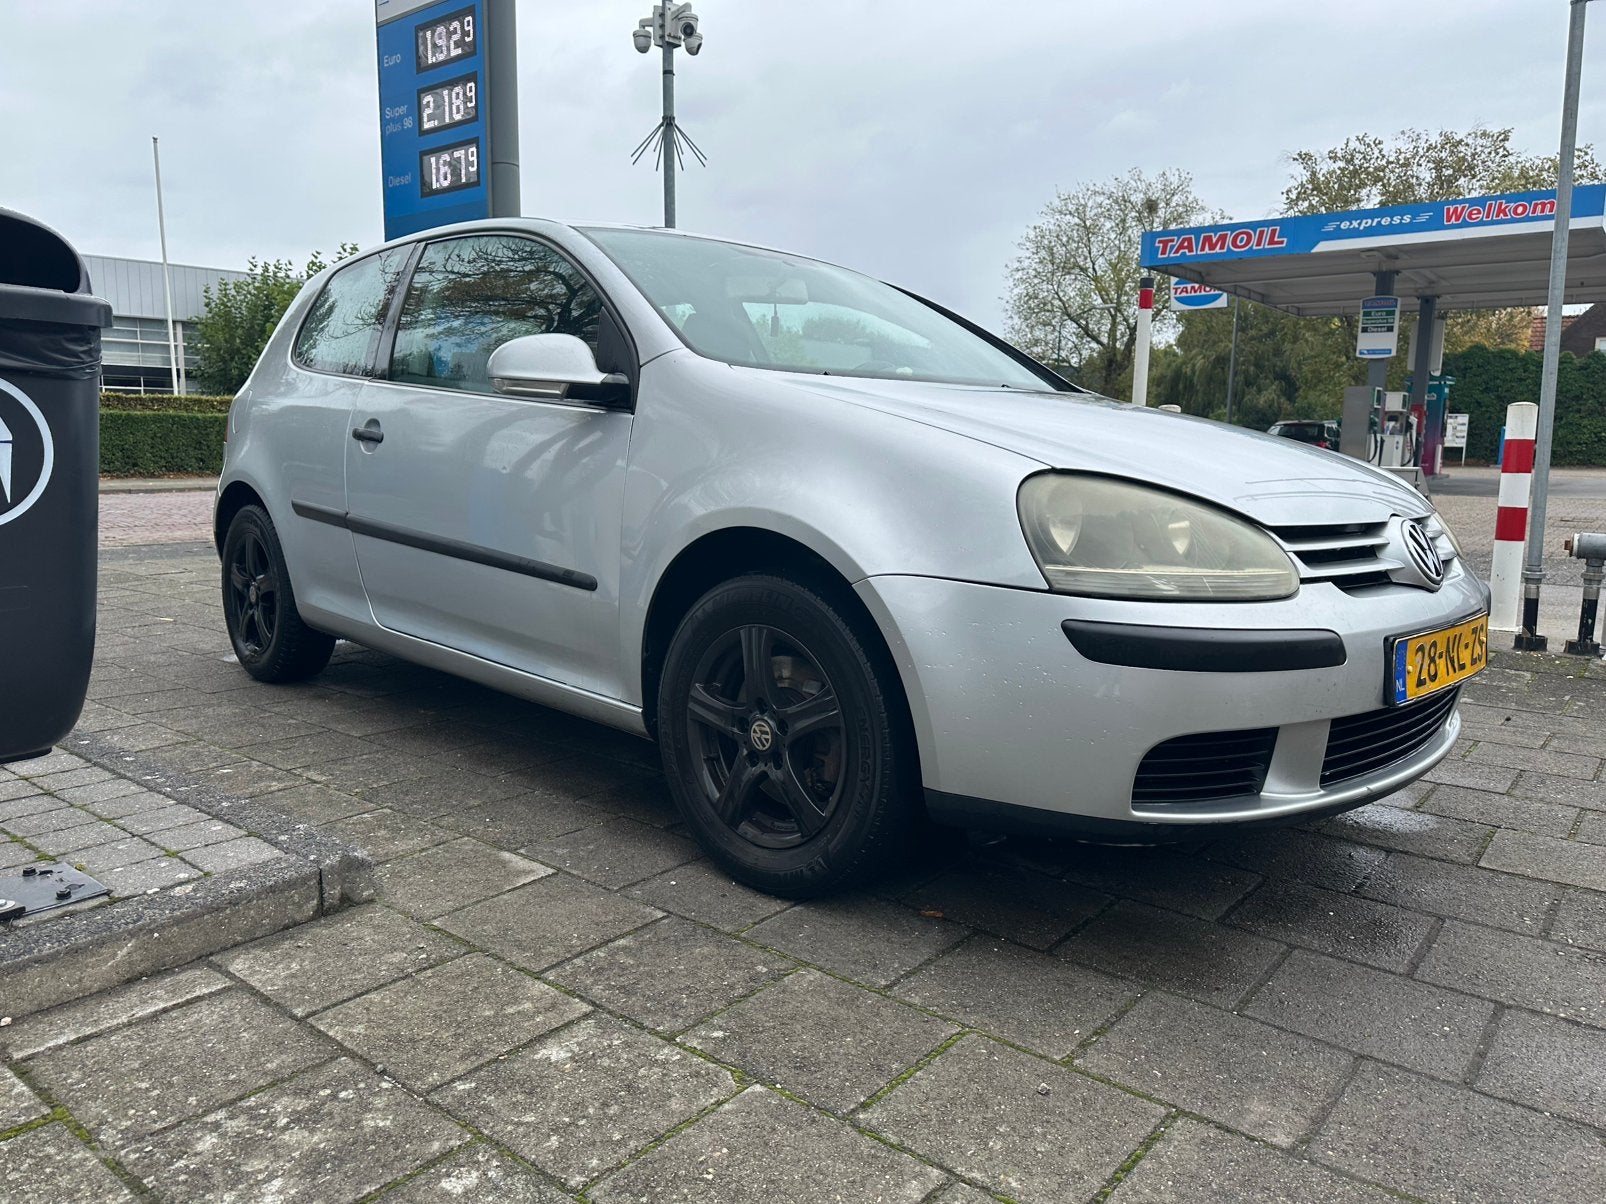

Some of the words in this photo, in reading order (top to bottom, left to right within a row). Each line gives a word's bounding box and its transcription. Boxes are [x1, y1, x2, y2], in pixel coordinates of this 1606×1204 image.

[384, 53, 401, 67] Euro
[385, 104, 408, 119] Super
[422, 82, 475, 129] 2.189
[386, 122, 401, 135] plus
[403, 116, 413, 129] 98
[388, 173, 412, 187] Diesel
[1444, 199, 1556, 225] Welkom
[1340, 213, 1411, 230] express
[1155, 226, 1287, 258] TAMOIL
[1416, 624, 1484, 688] 28-NL-ZS
[1396, 679, 1405, 691] NL
